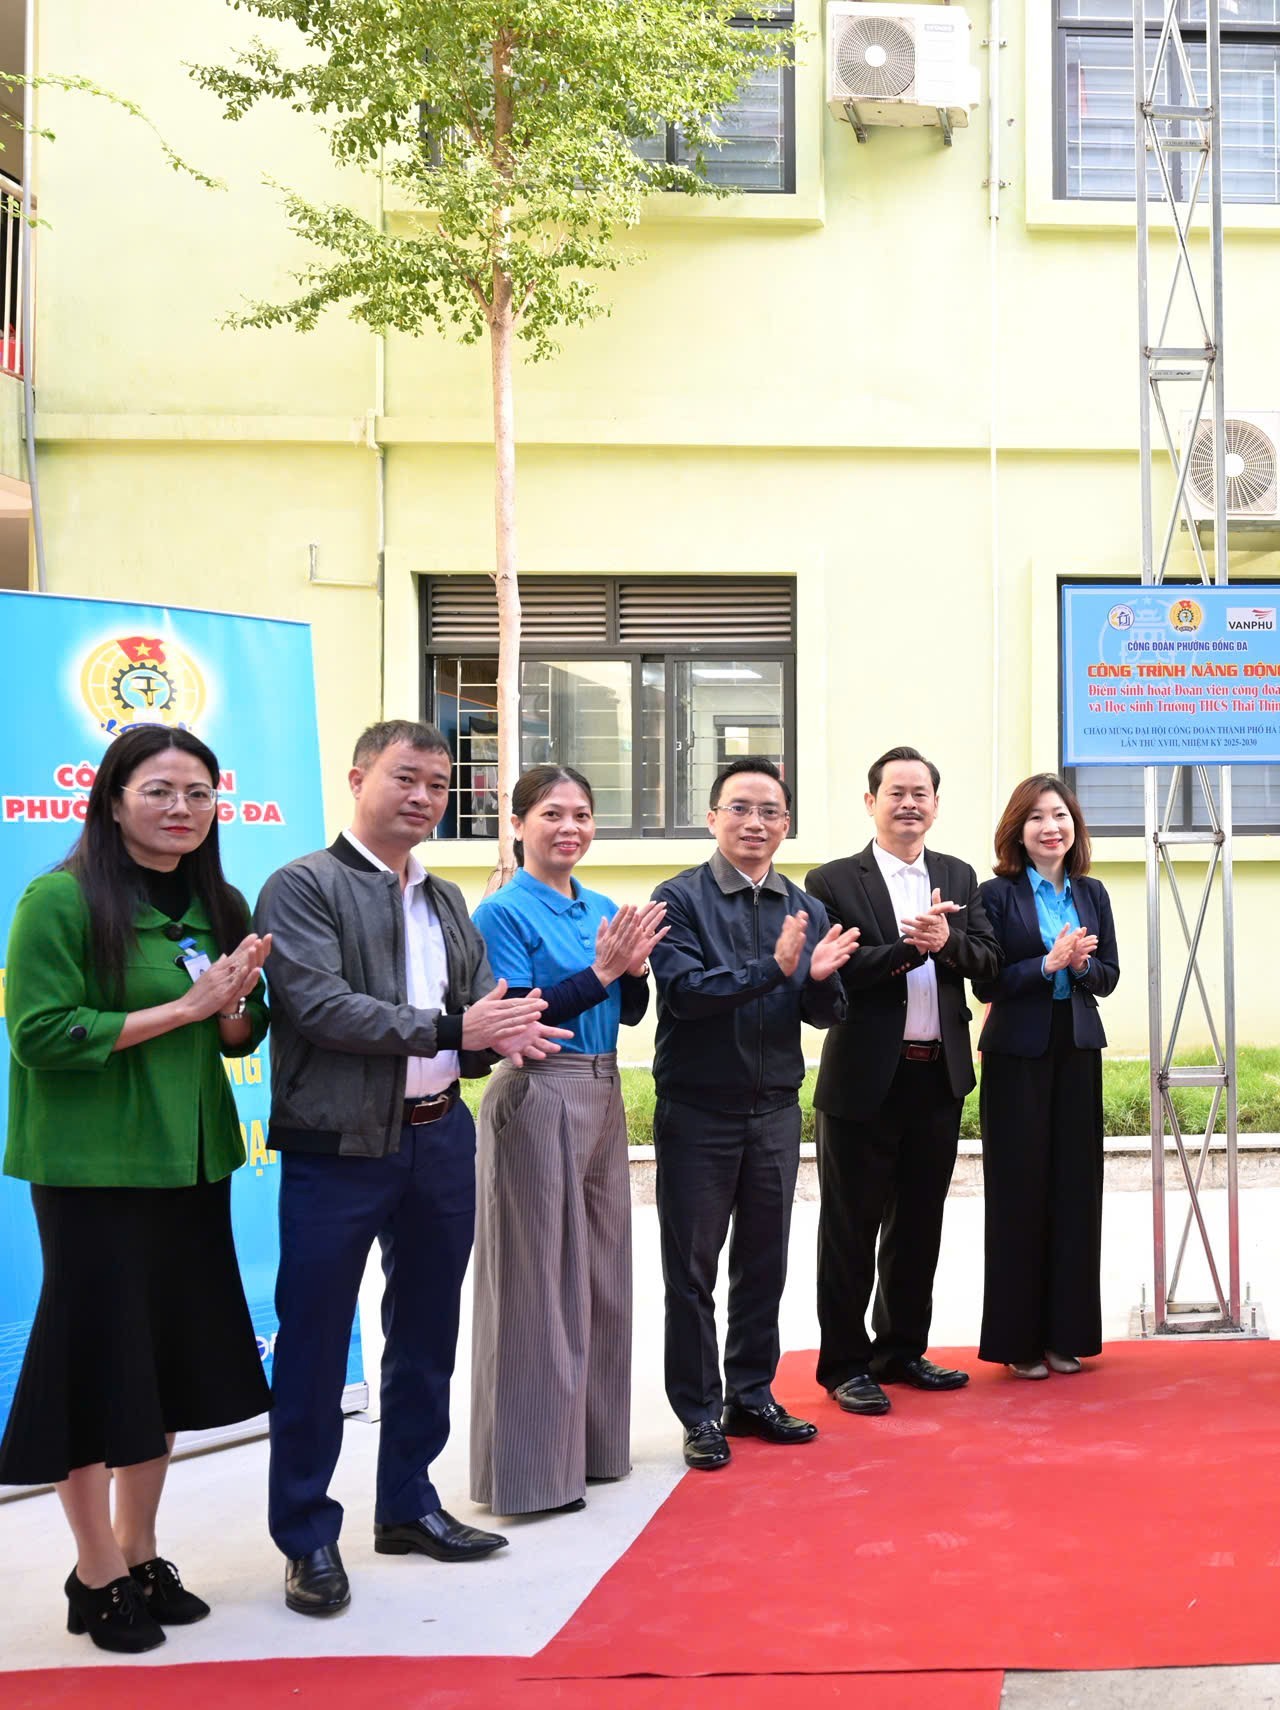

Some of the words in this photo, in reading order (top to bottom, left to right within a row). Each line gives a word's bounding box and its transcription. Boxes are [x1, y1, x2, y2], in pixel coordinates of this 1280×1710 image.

[1228, 621, 1273, 630] VANPHU
[1127, 639, 1150, 651] CÔNG
[1152, 639, 1175, 651] ĐOÀN
[1177, 639, 1210, 651] PHƯỜNG
[1212, 637, 1235, 651] ĐỐNG
[1237, 641, 1248, 651] ĐA
[1087, 662, 1132, 678] CÔNG
[1136, 662, 1186, 678] TRÌNH
[1191, 661, 1238, 677] NĂNG
[1120, 684, 1144, 696] sinh
[1147, 684, 1172, 698] hoạt
[1105, 700, 1126, 714] Học
[1129, 700, 1154, 712] sinh
[1199, 699, 1228, 712] THCS
[1231, 699, 1255, 712] Thái
[1223, 738, 1257, 747] 2025-2030
[57, 764, 96, 788] CÔ
[6, 795, 88, 820] PHƯỜ
[243, 803, 282, 822] ĐA
